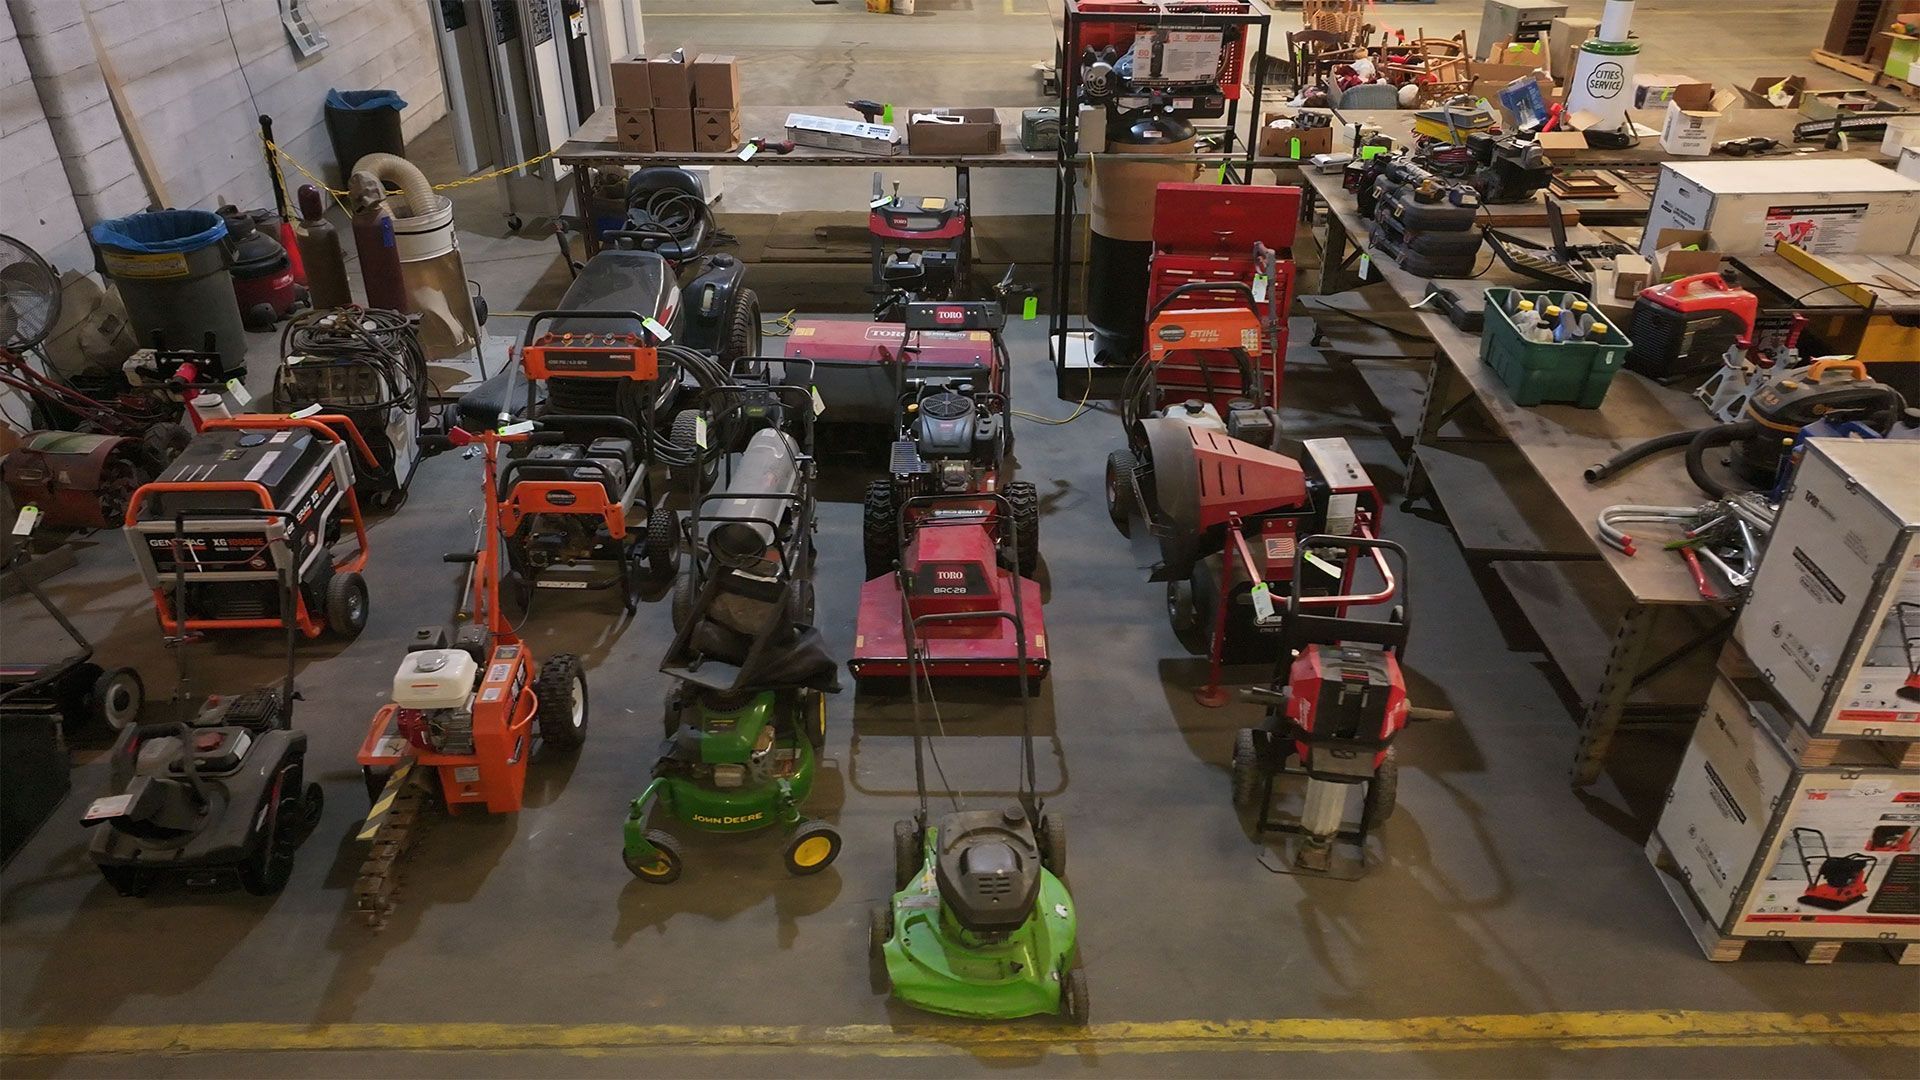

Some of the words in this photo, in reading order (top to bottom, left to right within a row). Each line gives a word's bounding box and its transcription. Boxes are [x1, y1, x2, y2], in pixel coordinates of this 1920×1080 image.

[1596, 70, 1620, 80] CITIES
[1590, 80, 1621, 90] SERVICE
[939, 311, 963, 319] TORO
[1190, 329, 1219, 338] STIHL
[212, 538, 227, 546] XG
[937, 571, 963, 579] TORO
[692, 814, 722, 824] JOHN
[723, 812, 763, 824] DEERE
